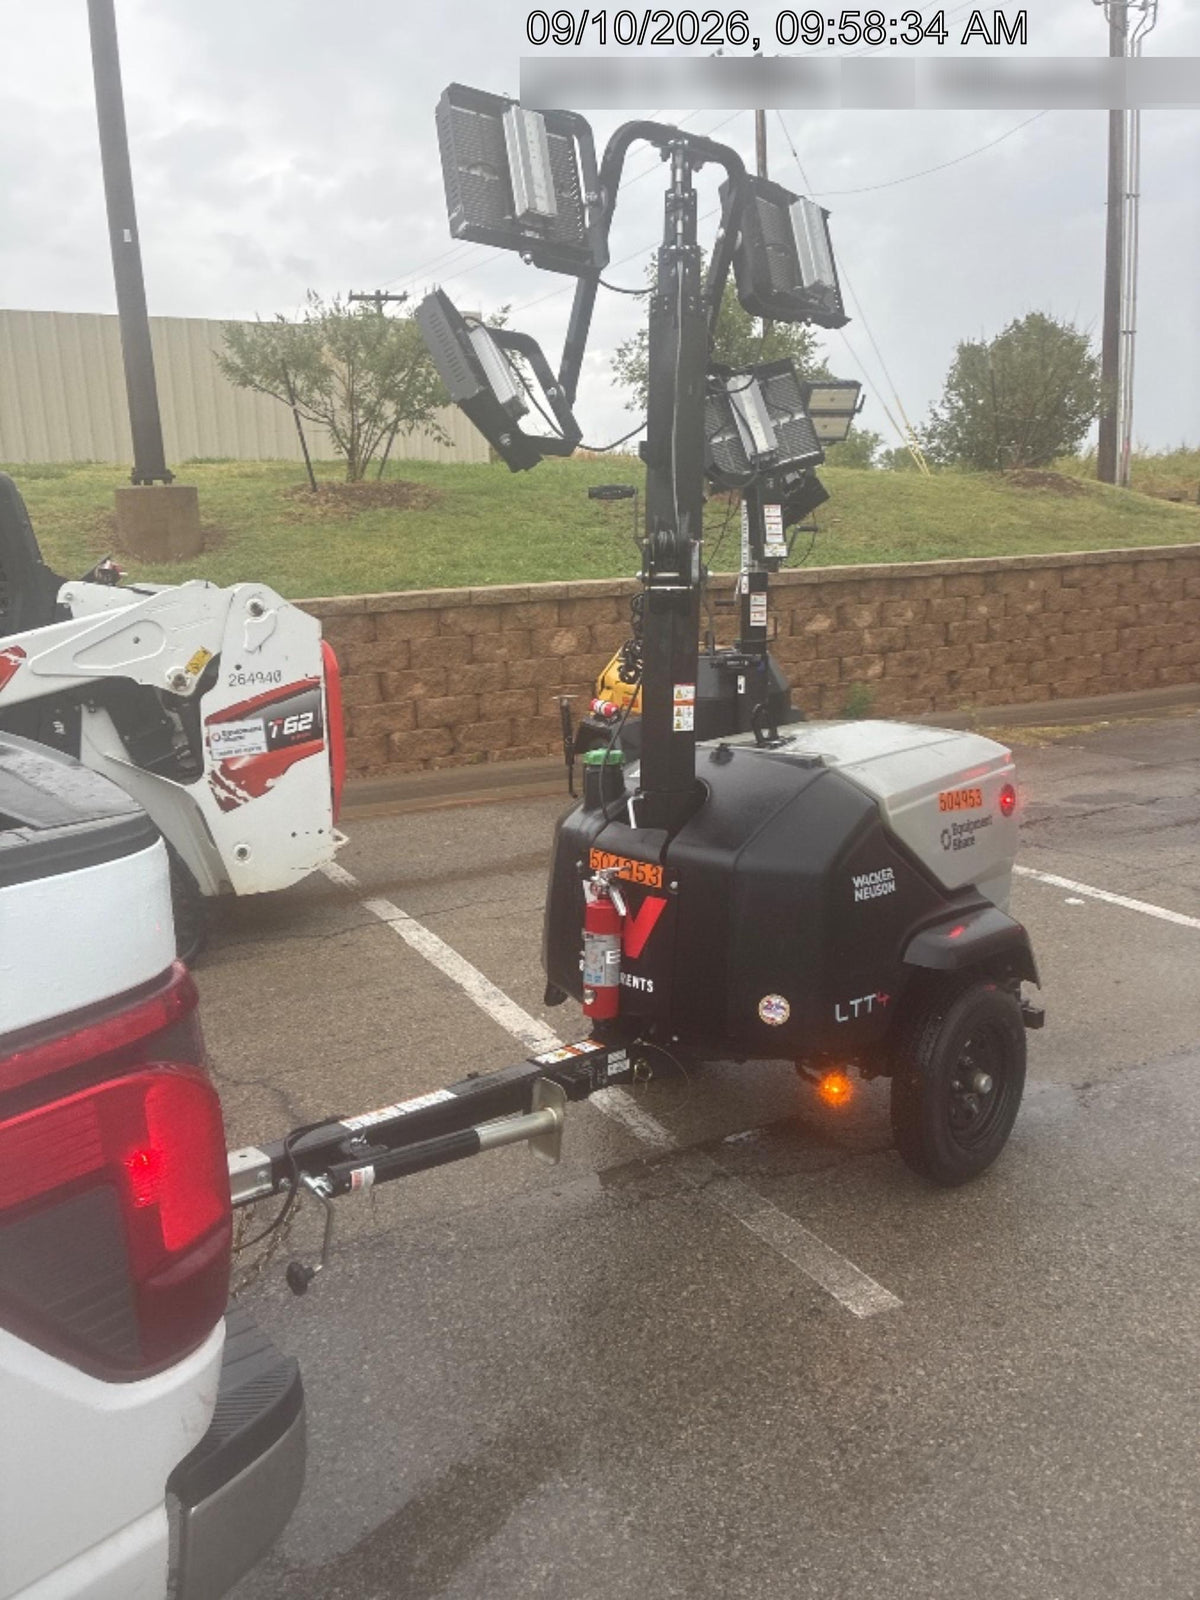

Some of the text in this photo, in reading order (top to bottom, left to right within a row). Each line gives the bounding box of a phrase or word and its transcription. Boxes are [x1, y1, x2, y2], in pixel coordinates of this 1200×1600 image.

[228, 670, 282, 687] 264940
[852, 867, 895, 888] WACKER
[854, 880, 896, 902] NEUSON
